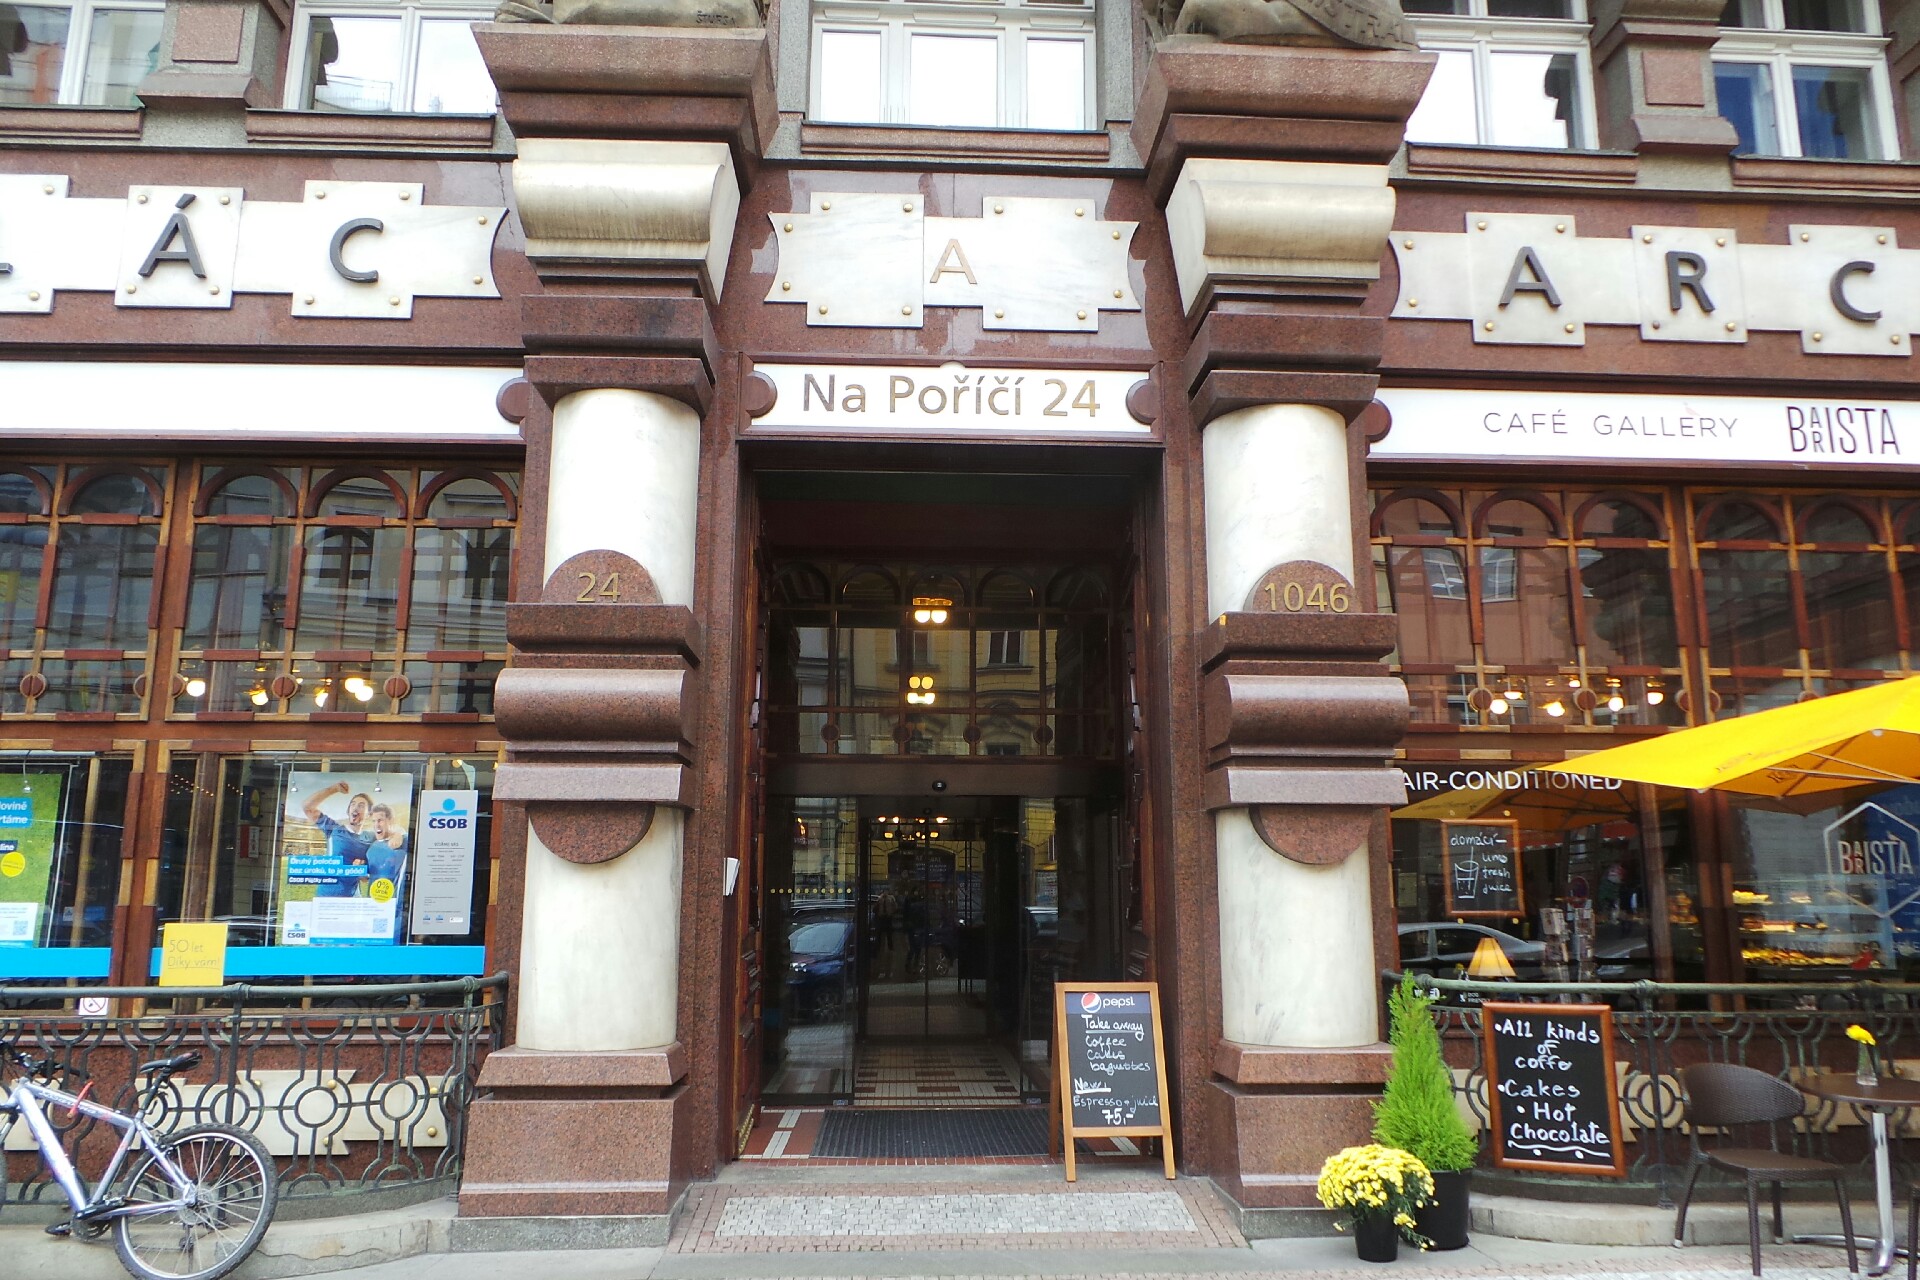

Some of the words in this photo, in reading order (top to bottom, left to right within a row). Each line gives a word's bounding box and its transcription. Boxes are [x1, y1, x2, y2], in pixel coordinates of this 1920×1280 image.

[930, 238, 977, 285] A
[802, 373, 868, 414] Na
[889, 374, 1023, 417] Poříčí
[1042, 379, 1101, 417] 24
[1483, 408, 1569, 435] CAFÉ
[1593, 413, 1739, 439] GALLERY
[576, 572, 621, 603] 24
[1264, 582, 1349, 613] 1046
[428, 817, 468, 829] ČSOB
[169, 940, 189, 953] 50
[192, 942, 204, 953] let
[1103, 996, 1135, 1009] pepsi
[1081, 1014, 1111, 1030] Take
[1113, 1021, 1145, 1041] away
[1547, 1020, 1600, 1044] kinds
[1085, 1035, 1127, 1052] Coffee
[1086, 1049, 1126, 1061] Cakes
[1090, 1061, 1151, 1076] baguettes
[1504, 1078, 1581, 1098] Cakes
[1533, 1101, 1577, 1121] Hot
[1510, 1121, 1611, 1144] Chocolate
